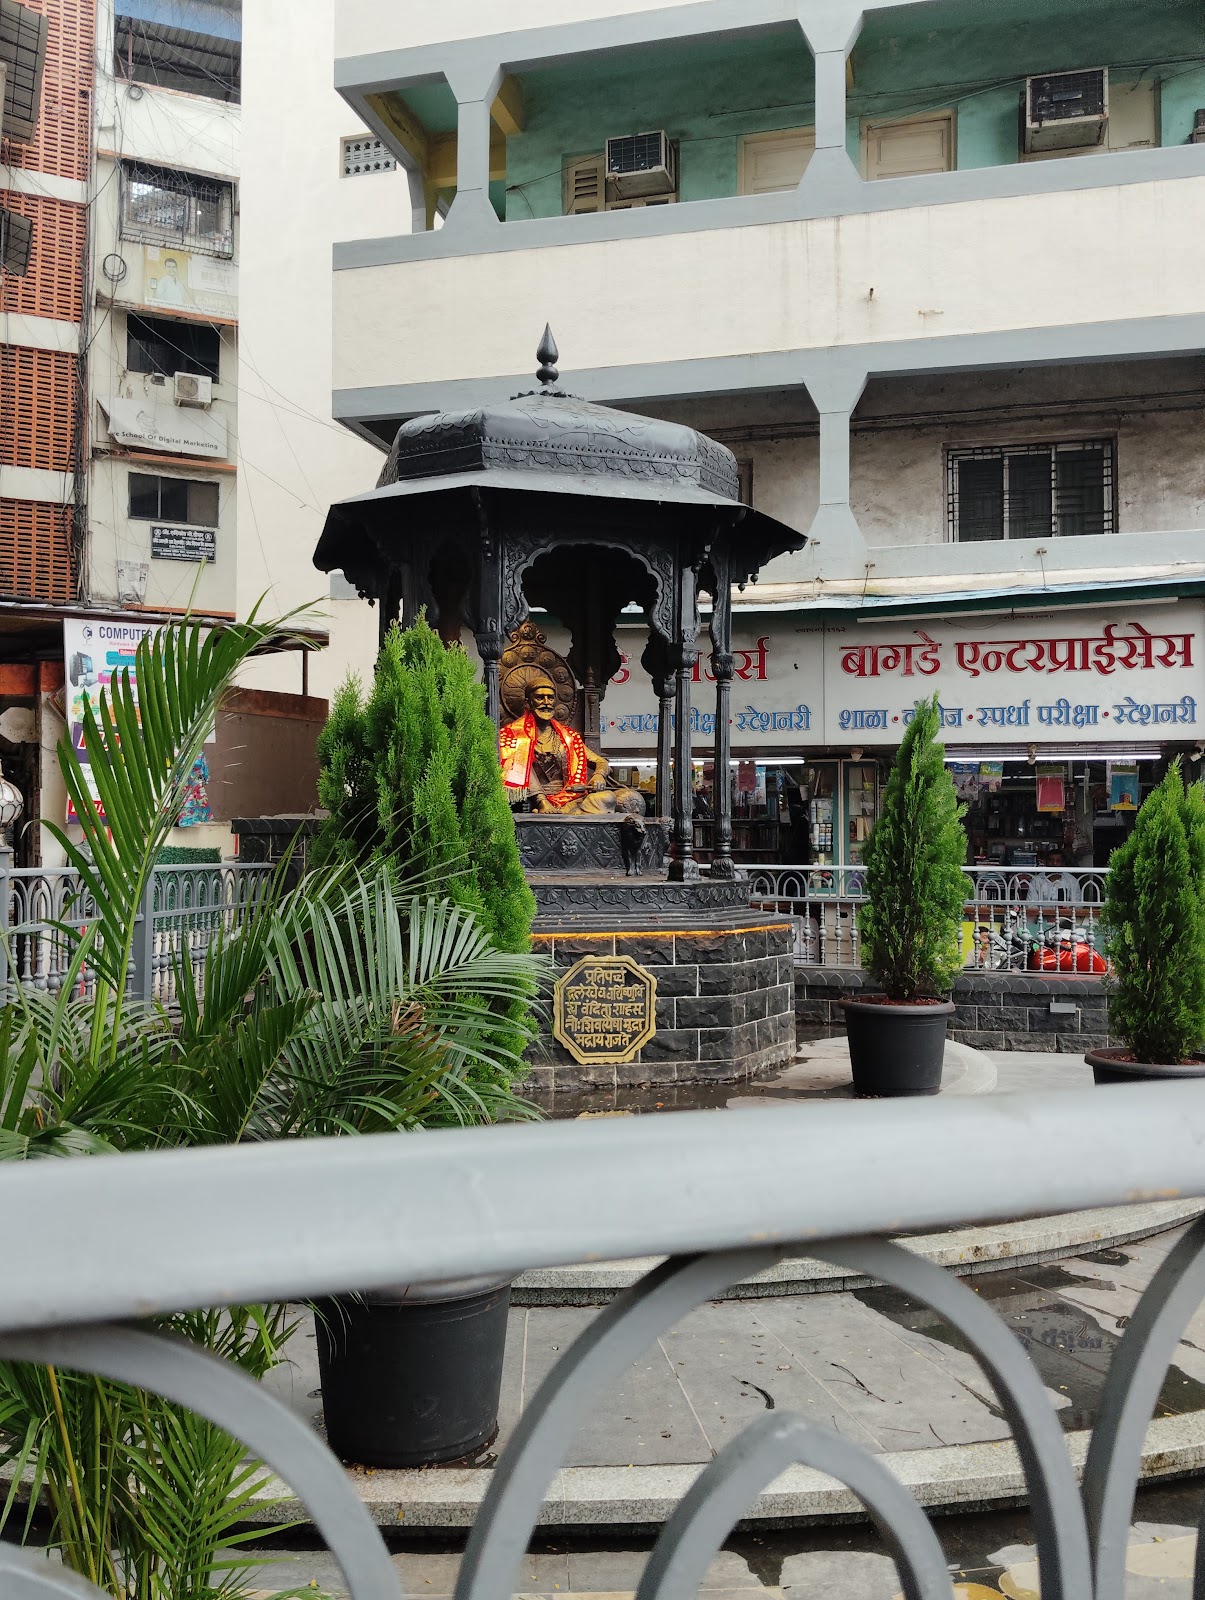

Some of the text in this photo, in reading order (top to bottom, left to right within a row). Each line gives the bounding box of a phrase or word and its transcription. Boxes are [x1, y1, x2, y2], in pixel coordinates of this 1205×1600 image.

[121, 431, 146, 440] School
[158, 435, 182, 445] Digital
[183, 439, 219, 450] Marketing
[99, 626, 153, 641] COMPUTER
[839, 622, 1195, 678] बागडे एन्टरप्राईसेस
[736, 704, 811, 732] स्टेशनरी
[839, 709, 889, 730] शाळा
[977, 698, 1030, 728] स्पर्धा
[1037, 698, 1099, 729] परीक्षा
[1112, 695, 1197, 726] स्टेशनरी
